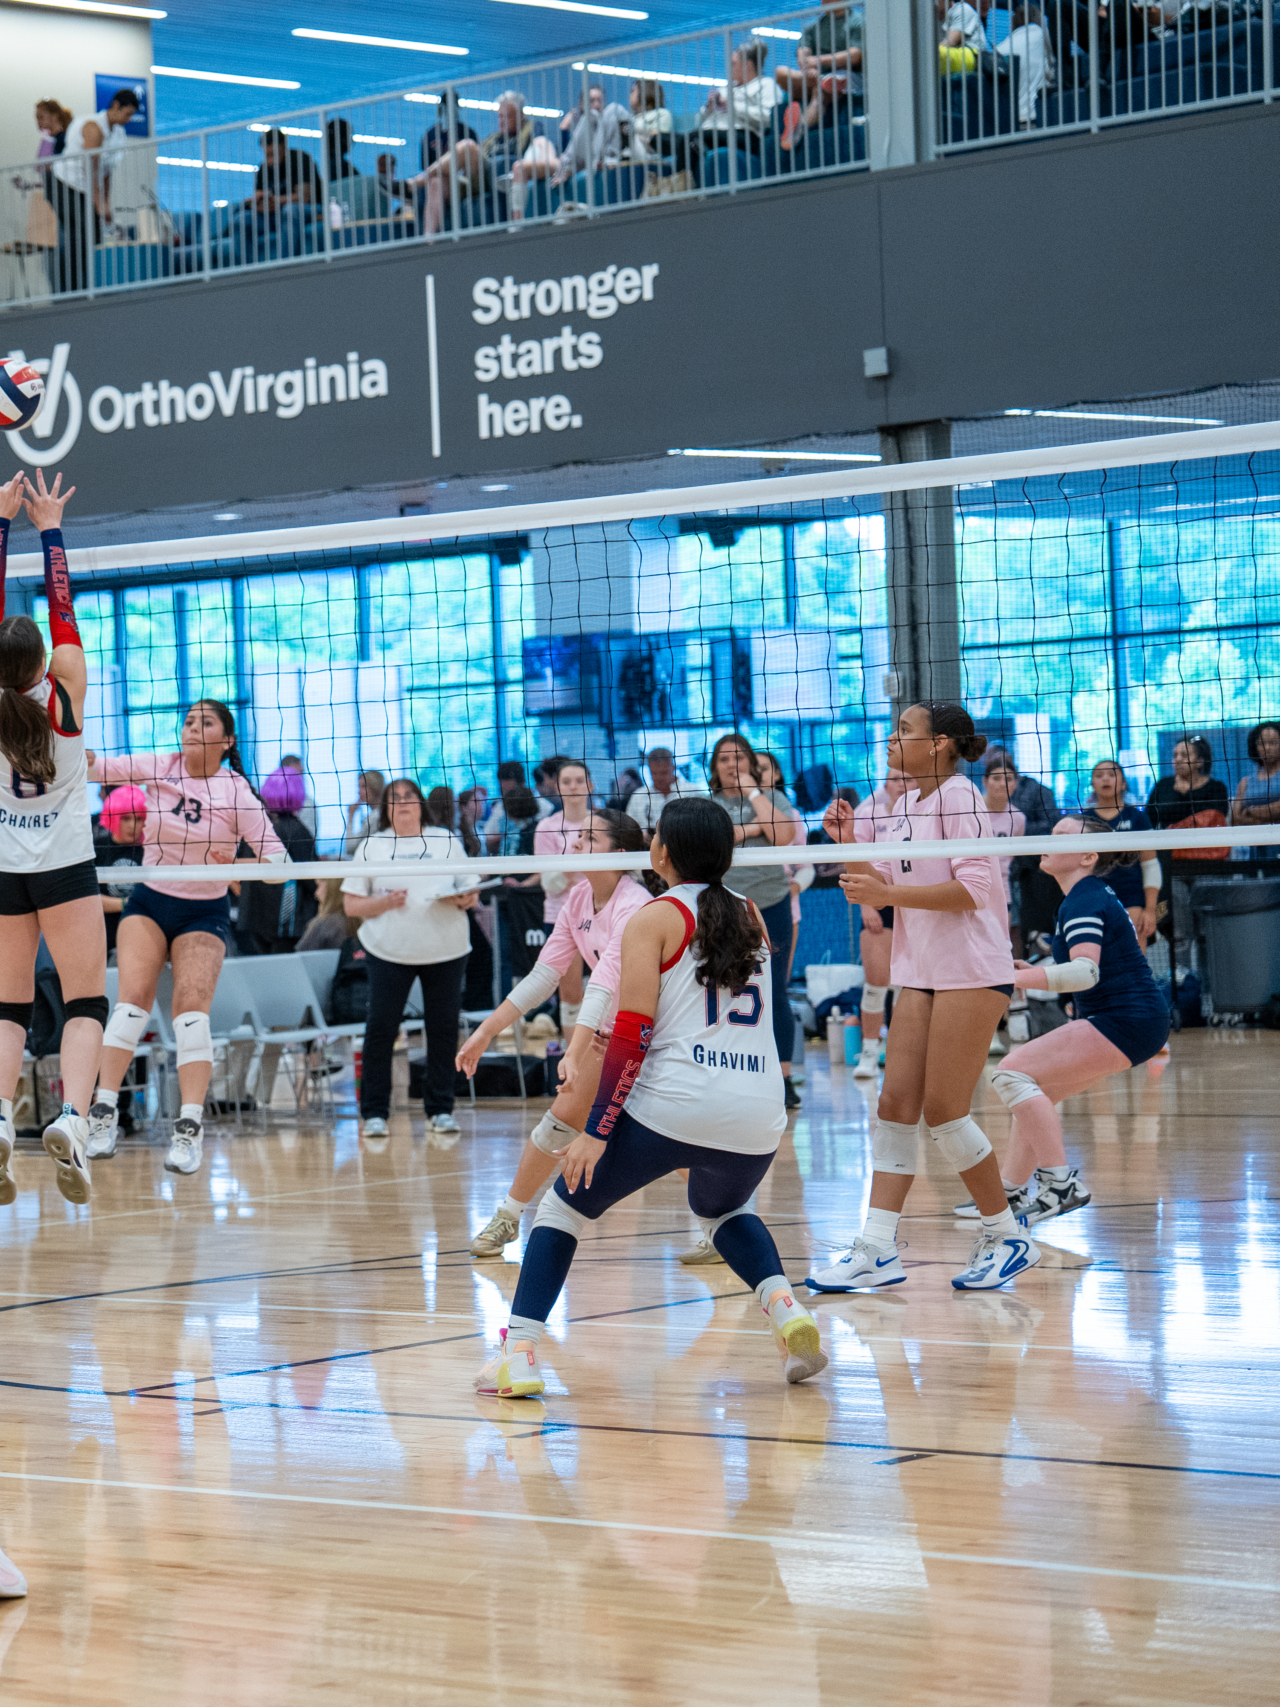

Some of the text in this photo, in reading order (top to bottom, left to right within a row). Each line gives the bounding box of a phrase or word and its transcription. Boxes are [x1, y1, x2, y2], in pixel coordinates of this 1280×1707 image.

[472, 263, 659, 325] Stronger
[474, 325, 603, 382] starts
[88, 351, 388, 433] OrthoVirginia
[477, 393, 583, 440] here.
[705, 960, 765, 1028] 15
[693, 1044, 766, 1073] GHAVIMI
